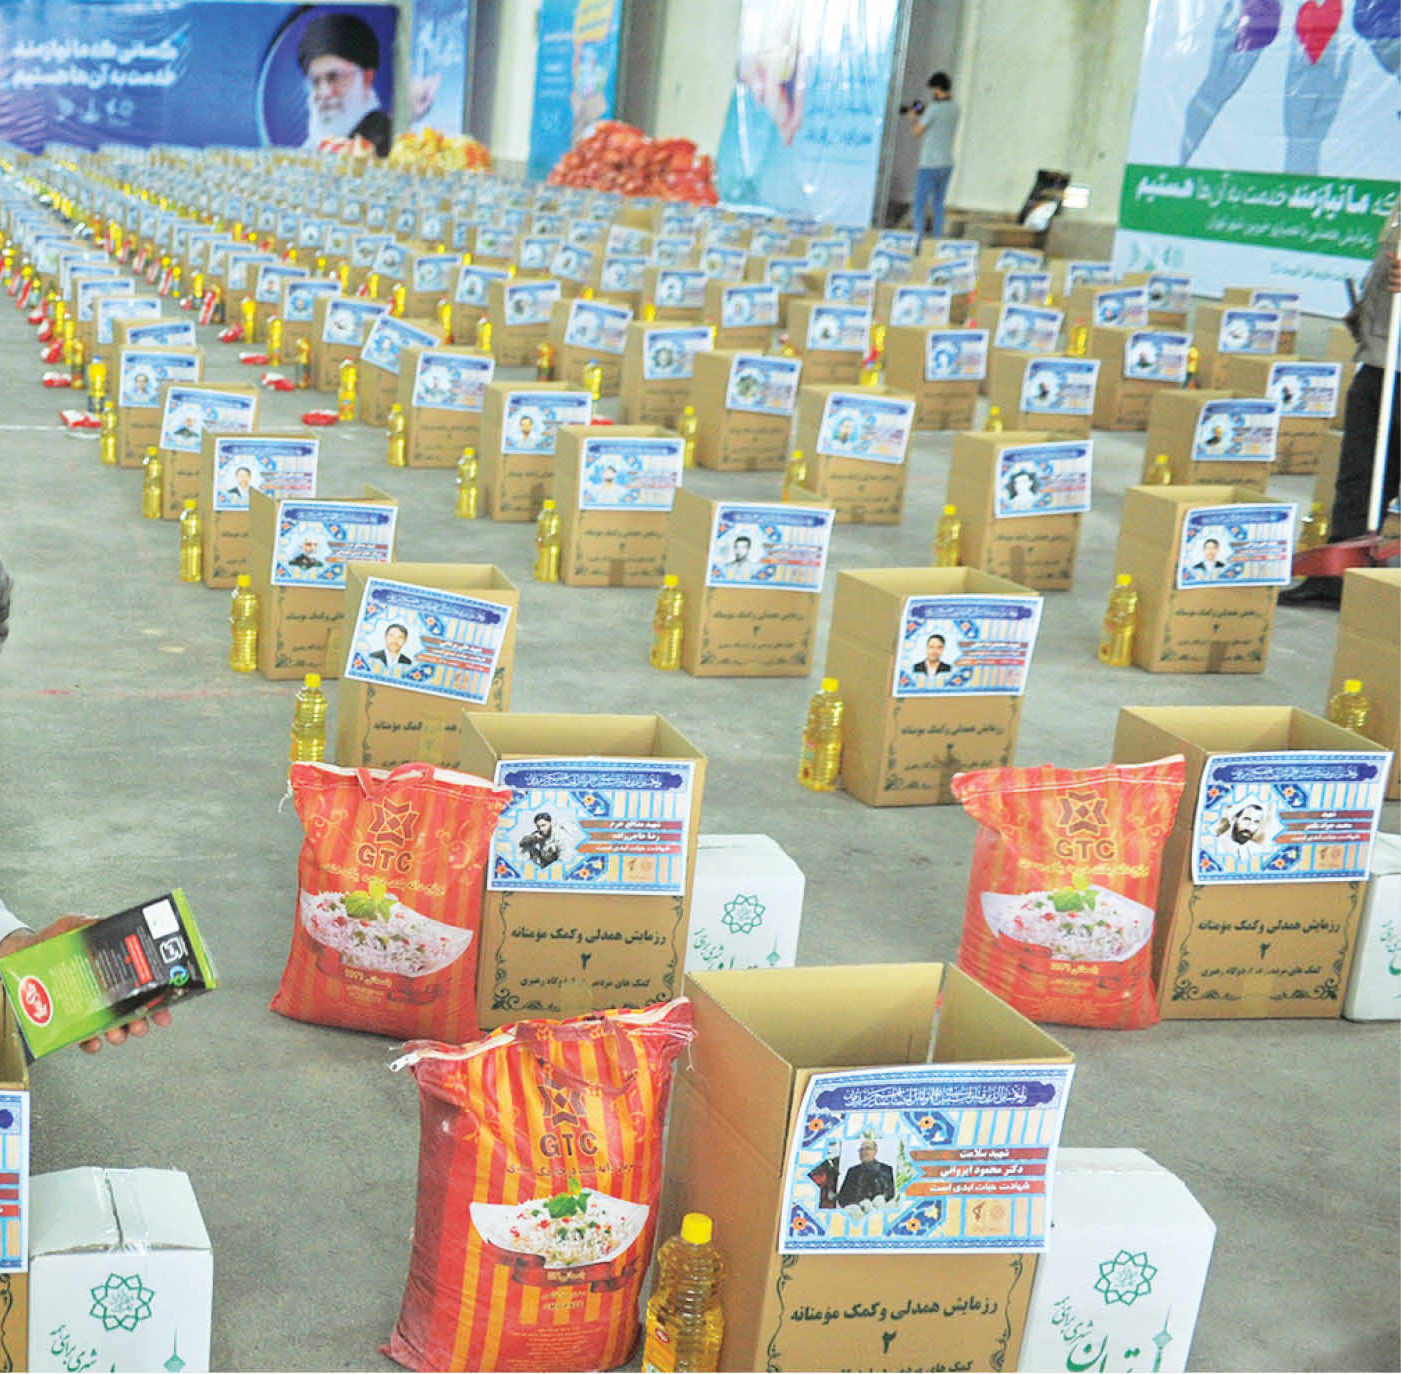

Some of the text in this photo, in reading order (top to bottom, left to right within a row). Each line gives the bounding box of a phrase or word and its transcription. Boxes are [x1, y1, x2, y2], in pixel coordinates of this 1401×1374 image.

[1055, 839, 1117, 861] GTC
[357, 845, 413, 873] GTC
[1266, 919, 1301, 934] همدلی
[1302, 919, 1342, 934] رزمایش
[585, 928, 623, 944] همدلی
[624, 930, 666, 945] رزمایش
[580, 952, 592, 970] ۲
[539, 1131, 598, 1159] GTC
[959, 1148, 1010, 1160] شهید سلامت
[974, 1168, 1002, 1178] محمود
[1003, 1165, 1024, 1176] دکتر
[929, 1181, 1031, 1193] شهادت حیات ابدی است
[890, 1299, 940, 1320] همدلی
[943, 1295, 998, 1317] رزمایش
[882, 1329, 897, 1354] ۲
